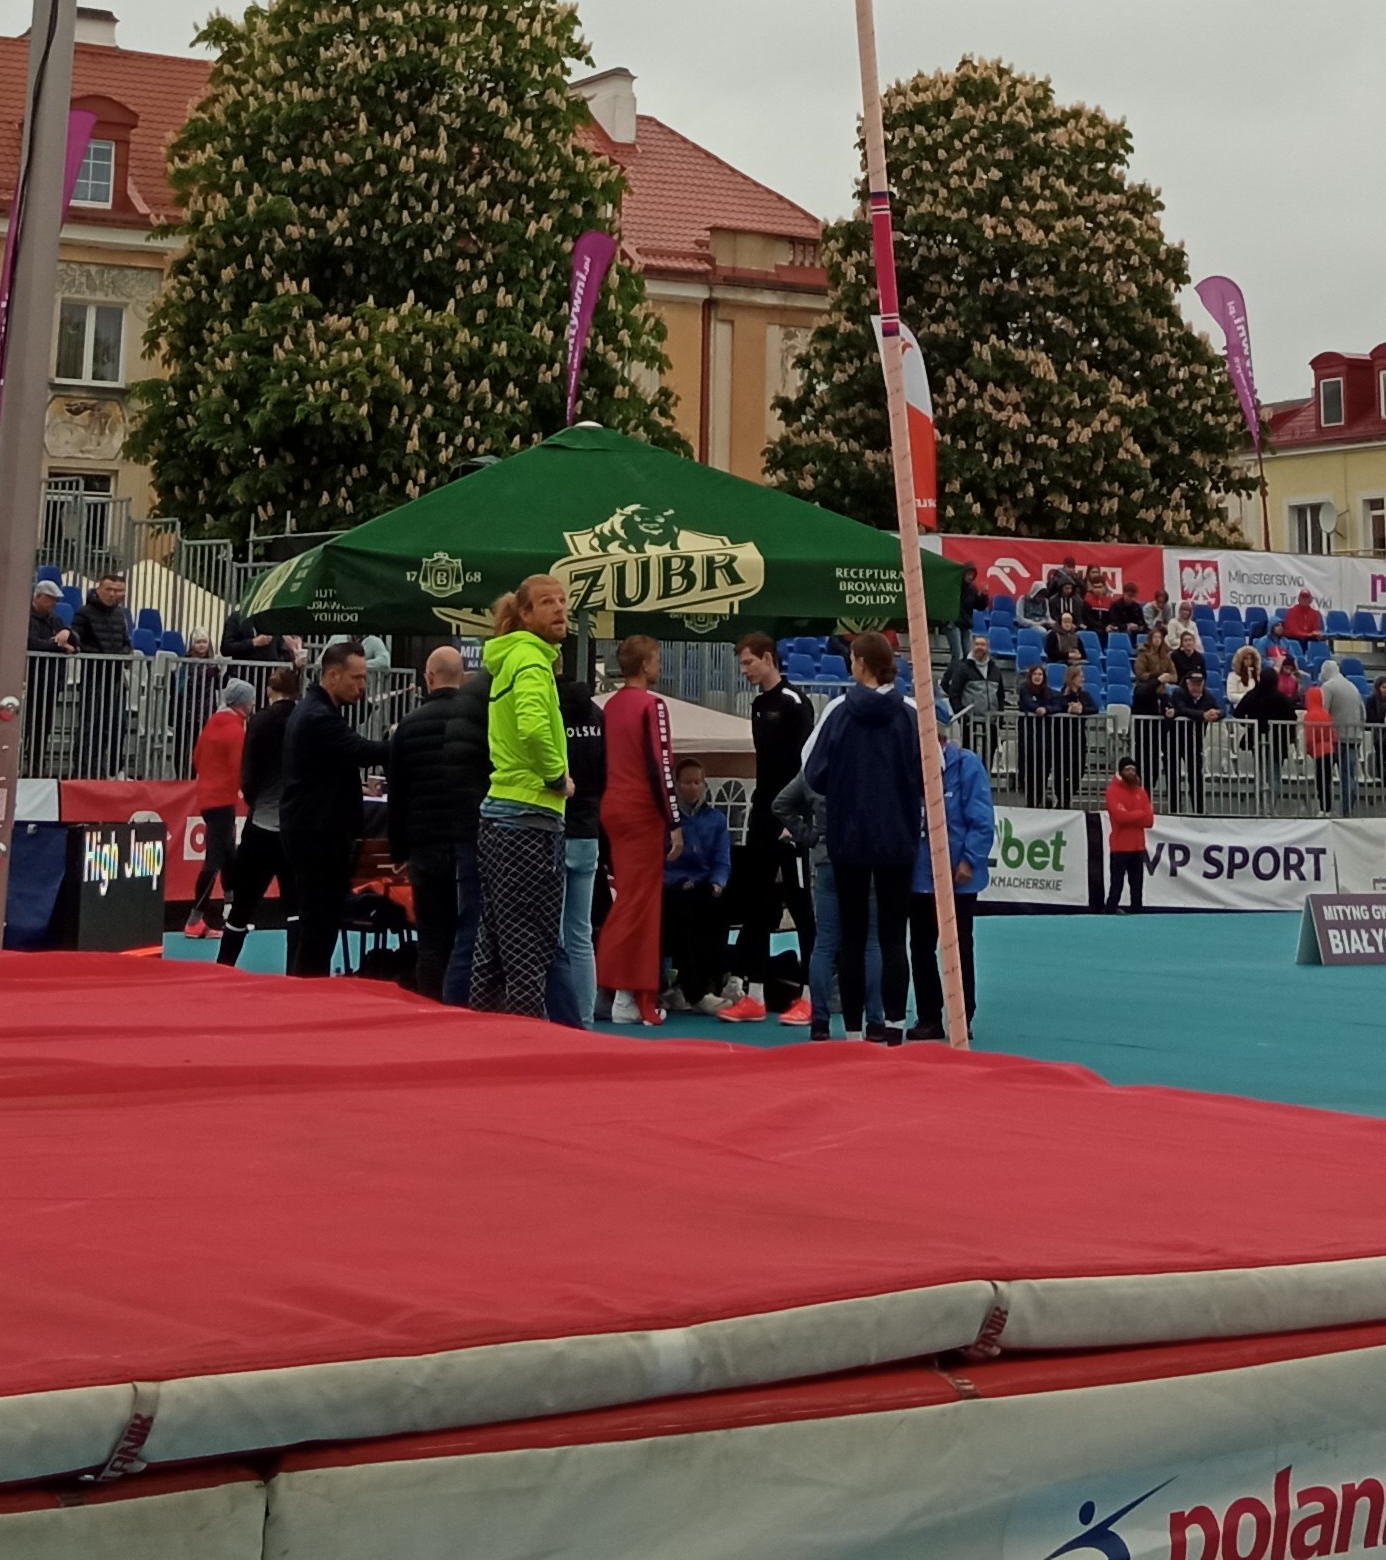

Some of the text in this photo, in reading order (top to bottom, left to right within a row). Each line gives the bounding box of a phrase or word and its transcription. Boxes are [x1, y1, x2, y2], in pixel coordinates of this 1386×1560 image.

[466, 571, 482, 583] 68
[1228, 569, 1305, 587] Ministerstwo
[839, 581, 903, 593] BROWARU
[845, 594, 898, 606] DOJLIDY
[1230, 590, 1271, 608] Sportu
[566, 726, 602, 738] OLSKA
[83, 831, 119, 896] High
[125, 829, 163, 890] Jump
[1202, 844, 1327, 881] SPORT
[990, 876, 1063, 891] KMACHERSKIE
[1323, 905, 1370, 920] MITYNG
